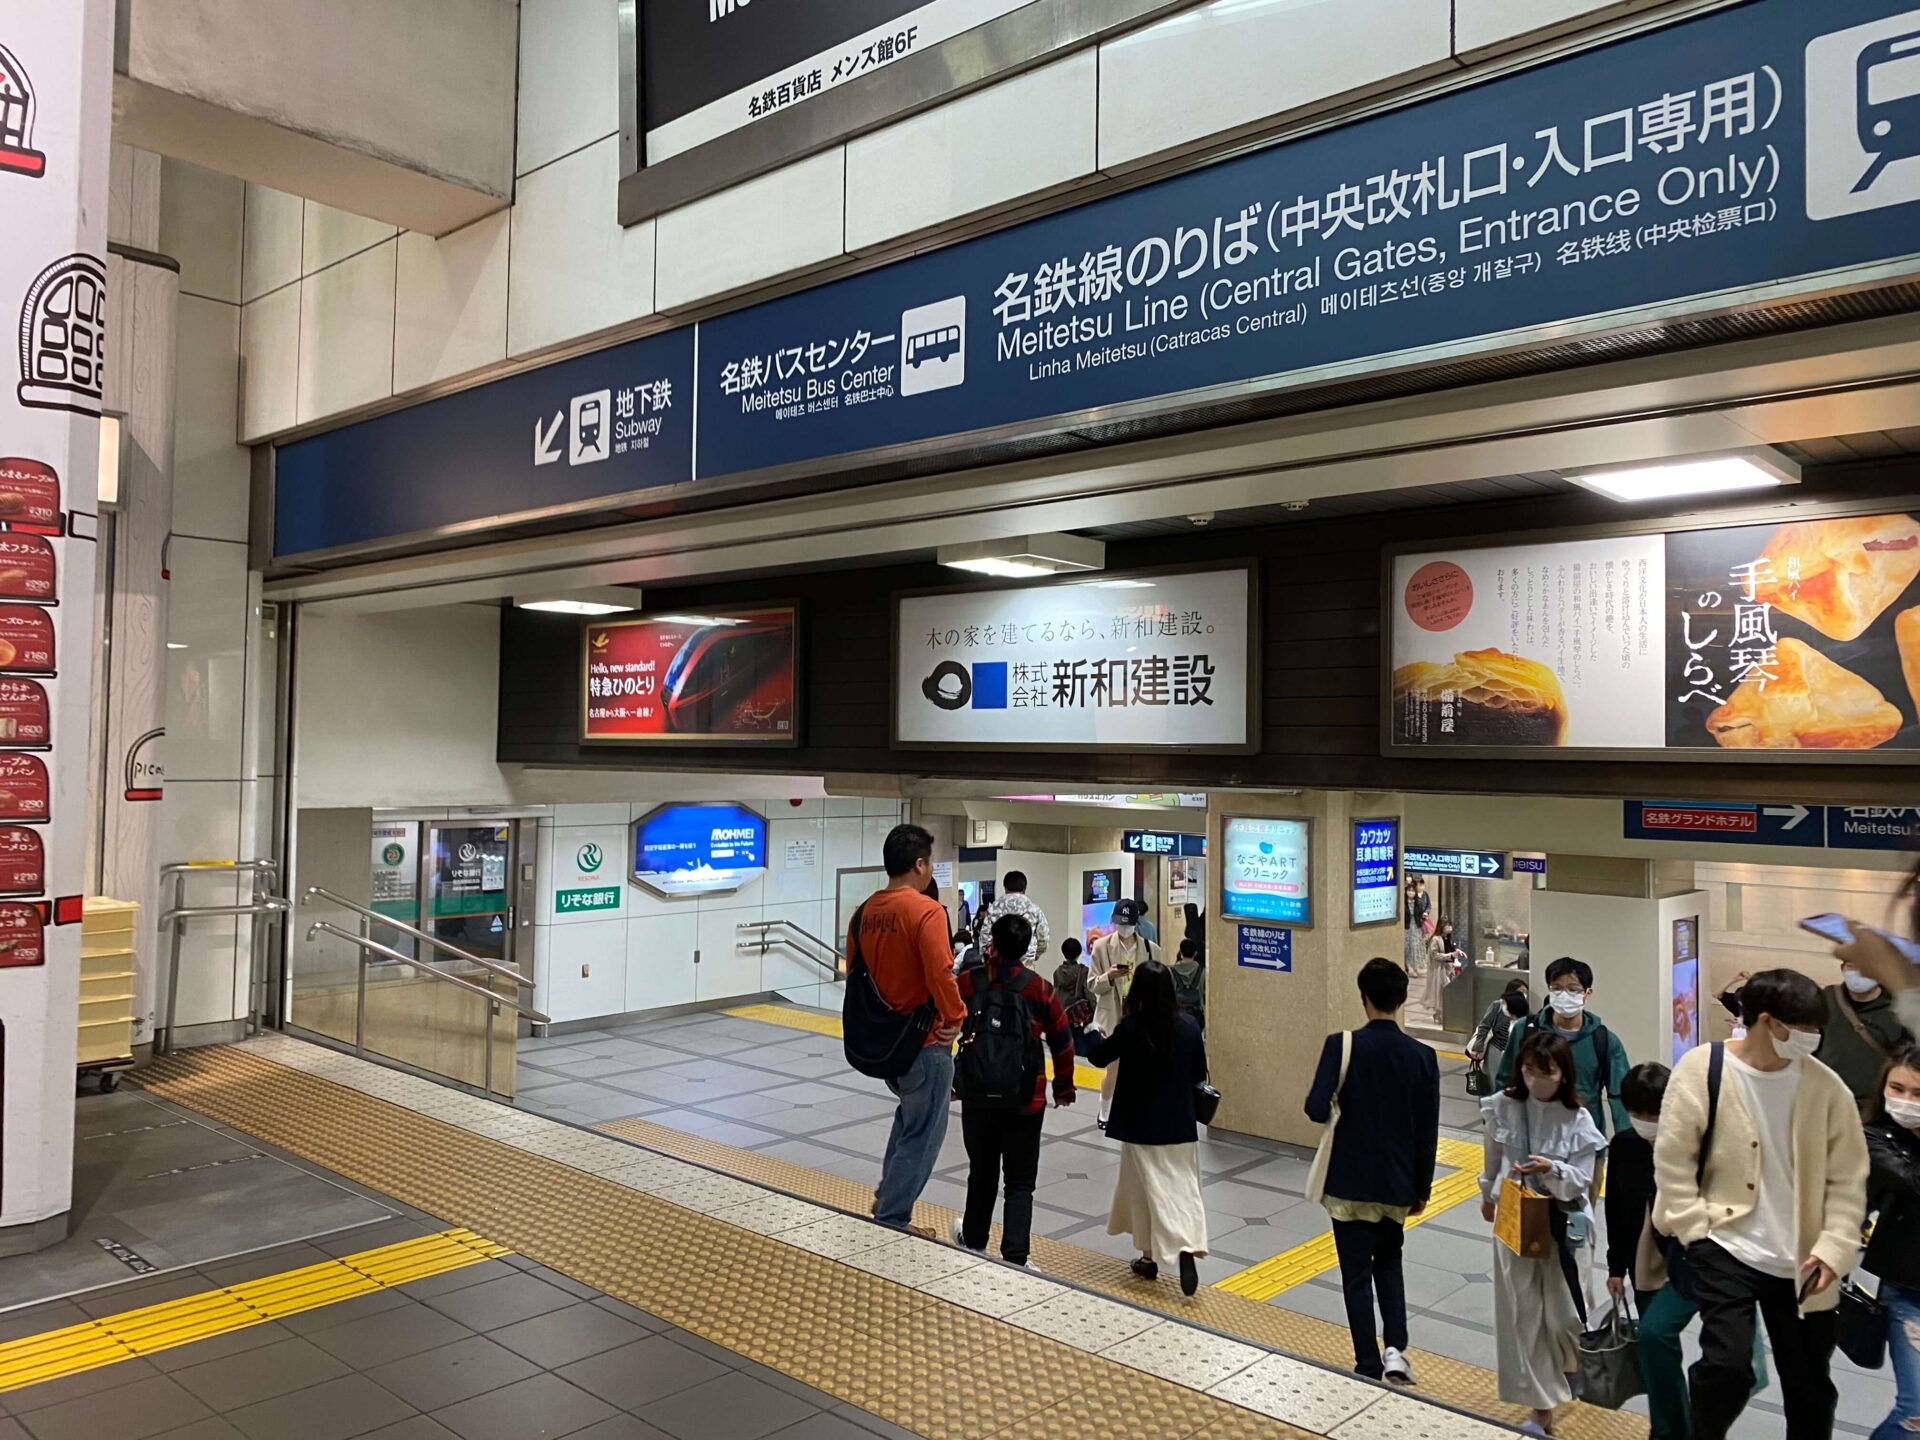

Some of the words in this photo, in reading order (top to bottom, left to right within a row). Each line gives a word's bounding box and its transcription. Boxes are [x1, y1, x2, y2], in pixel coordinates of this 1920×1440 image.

[748, 69, 822, 118] 名鉄百貨店
[831, 26, 918, 83] メンズ館6F
[997, 312, 1113, 362] Meitetsu
[1125, 294, 1188, 332] Line
[1200, 256, 1320, 320] (Central
[1334, 241, 1447, 284] Gates,
[1459, 187, 1641, 256] Entrance
[1656, 145, 1780, 207] Only)
[1320, 268, 1467, 317] 메이테츠선(중앙
[1473, 251, 1542, 284] 개찰구)
[1029, 358, 1071, 381] Linha
[1076, 342, 1147, 370] Meitetsu
[1150, 325, 1230, 358] (Catracas
[1236, 302, 1308, 336] Central)
[720, 330, 895, 395] 名鉄バスセンター
[616, 378, 672, 418] 地下鉄
[741, 386, 801, 414] Meitetsu
[807, 378, 836, 400] Bus
[841, 364, 895, 391] Center
[808, 396, 839, 415] 버스센터
[615, 416, 662, 439] Subway
[926, 611, 1216, 650] 木の家を建てるなら、新和建設。
[1728, 558, 1780, 693] 手風琴
[1678, 591, 1727, 706] のしらべ
[590, 662, 609, 676] Hello,
[610, 664, 623, 673] new
[625, 660, 656, 673] standard!
[1012, 662, 1049, 684] 株式
[590, 675, 655, 698] 特急ひのとり
[1052, 654, 1216, 709] 新和建設
[1012, 685, 1049, 708] 会社
[1647, 812, 1753, 828] 名鉄グランドホテル
[1844, 821, 1911, 836] Meitetsu
[1360, 829, 1391, 845] カワカツ
[1237, 854, 1297, 868] なごやART
[1243, 867, 1288, 880] クリニック
[561, 891, 615, 908] りそな銀行
